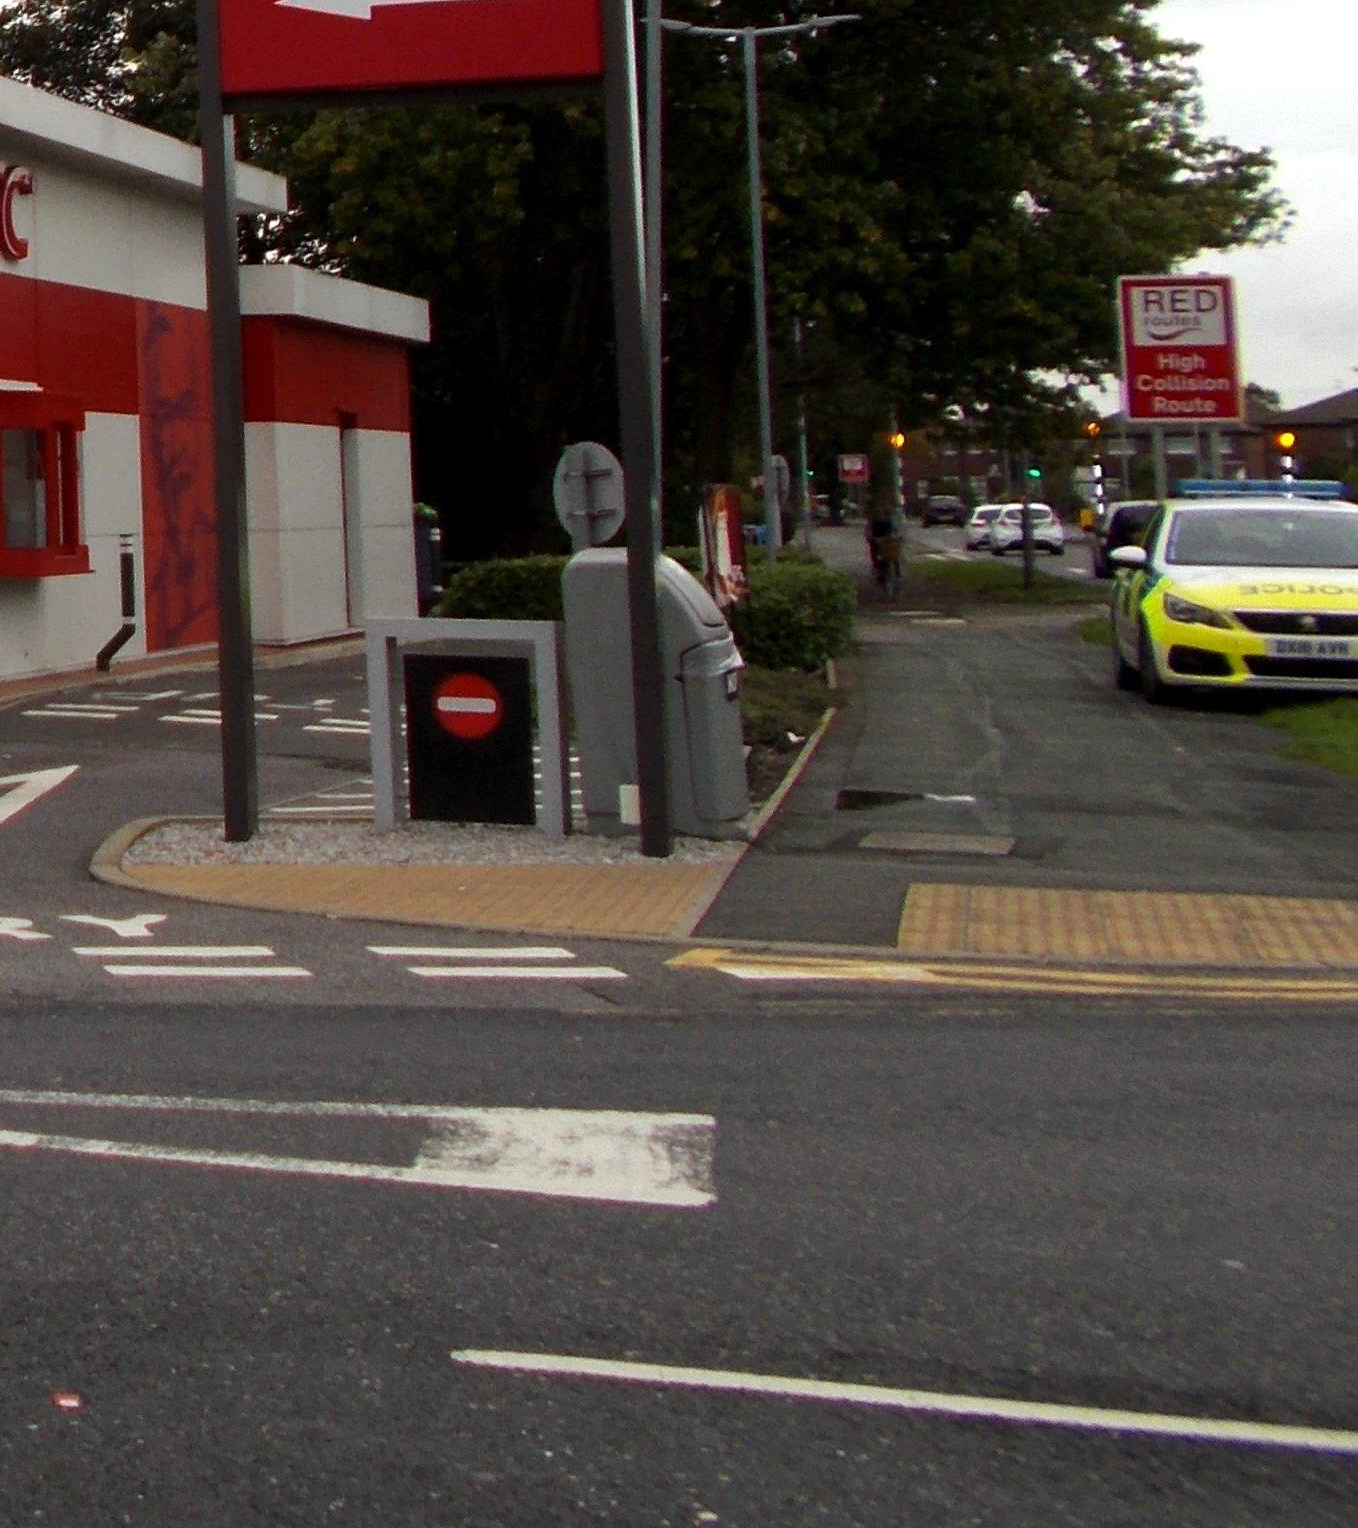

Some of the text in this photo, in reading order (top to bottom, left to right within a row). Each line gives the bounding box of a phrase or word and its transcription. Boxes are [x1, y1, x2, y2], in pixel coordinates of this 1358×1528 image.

[1143, 288, 1219, 313] RED
[1156, 353, 1207, 373] High
[1137, 374, 1231, 392] Collision
[1153, 396, 1218, 413] Route
